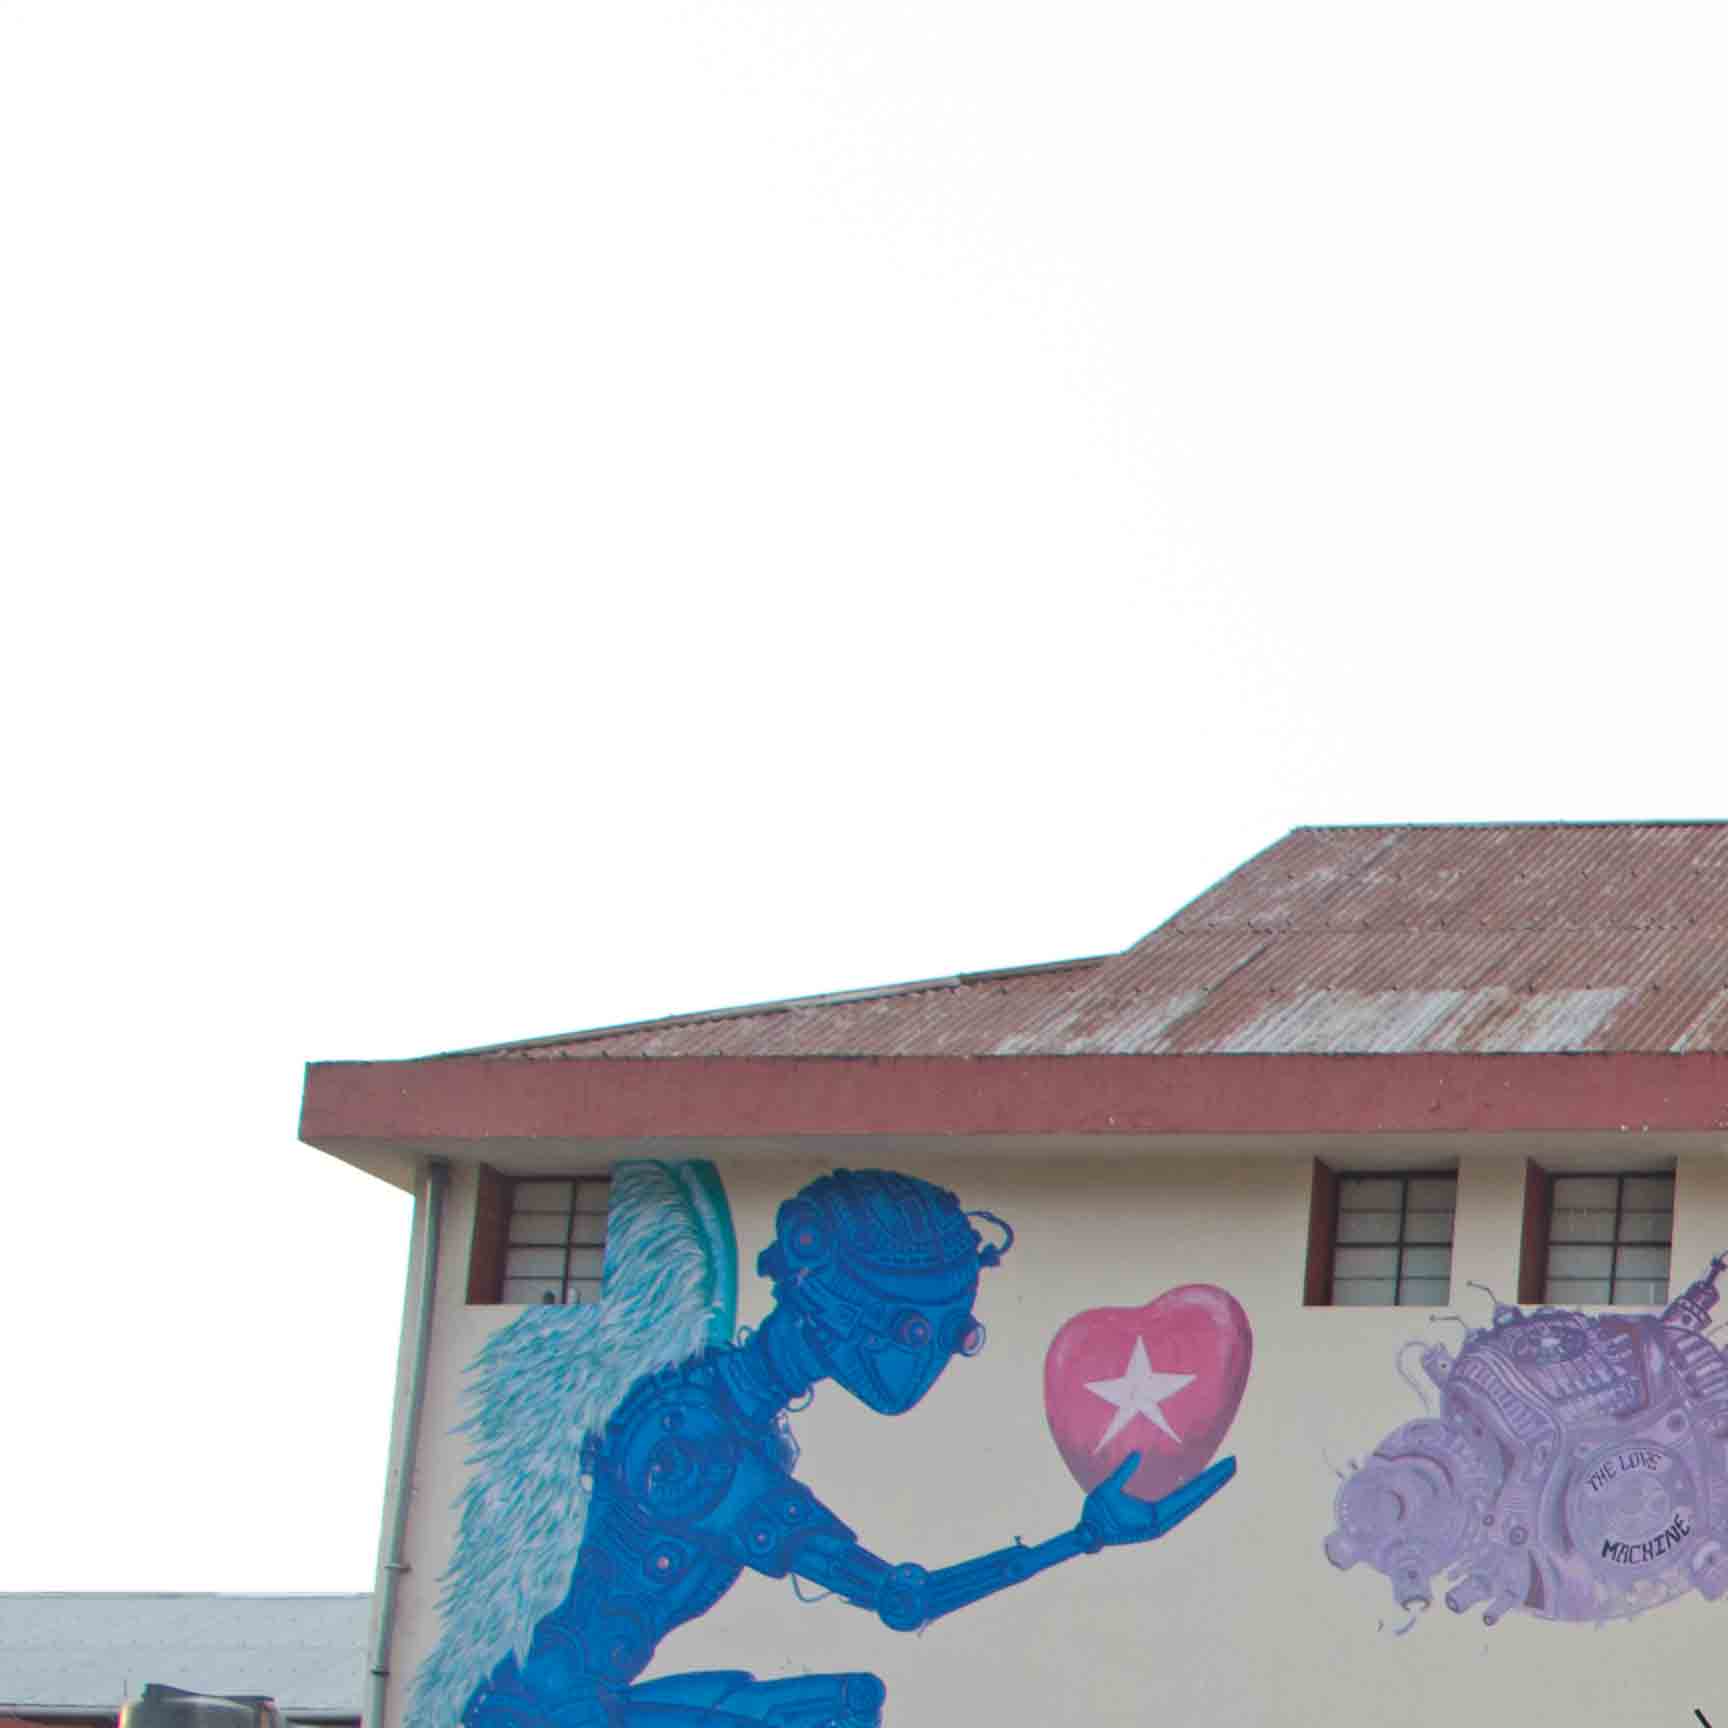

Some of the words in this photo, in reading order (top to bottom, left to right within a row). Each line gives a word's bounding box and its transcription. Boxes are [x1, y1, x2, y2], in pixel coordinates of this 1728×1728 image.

[1584, 1463, 1617, 1492] THE
[1618, 1450, 1662, 1471] LOVE
[1601, 1513, 1692, 1564] MACHINE
